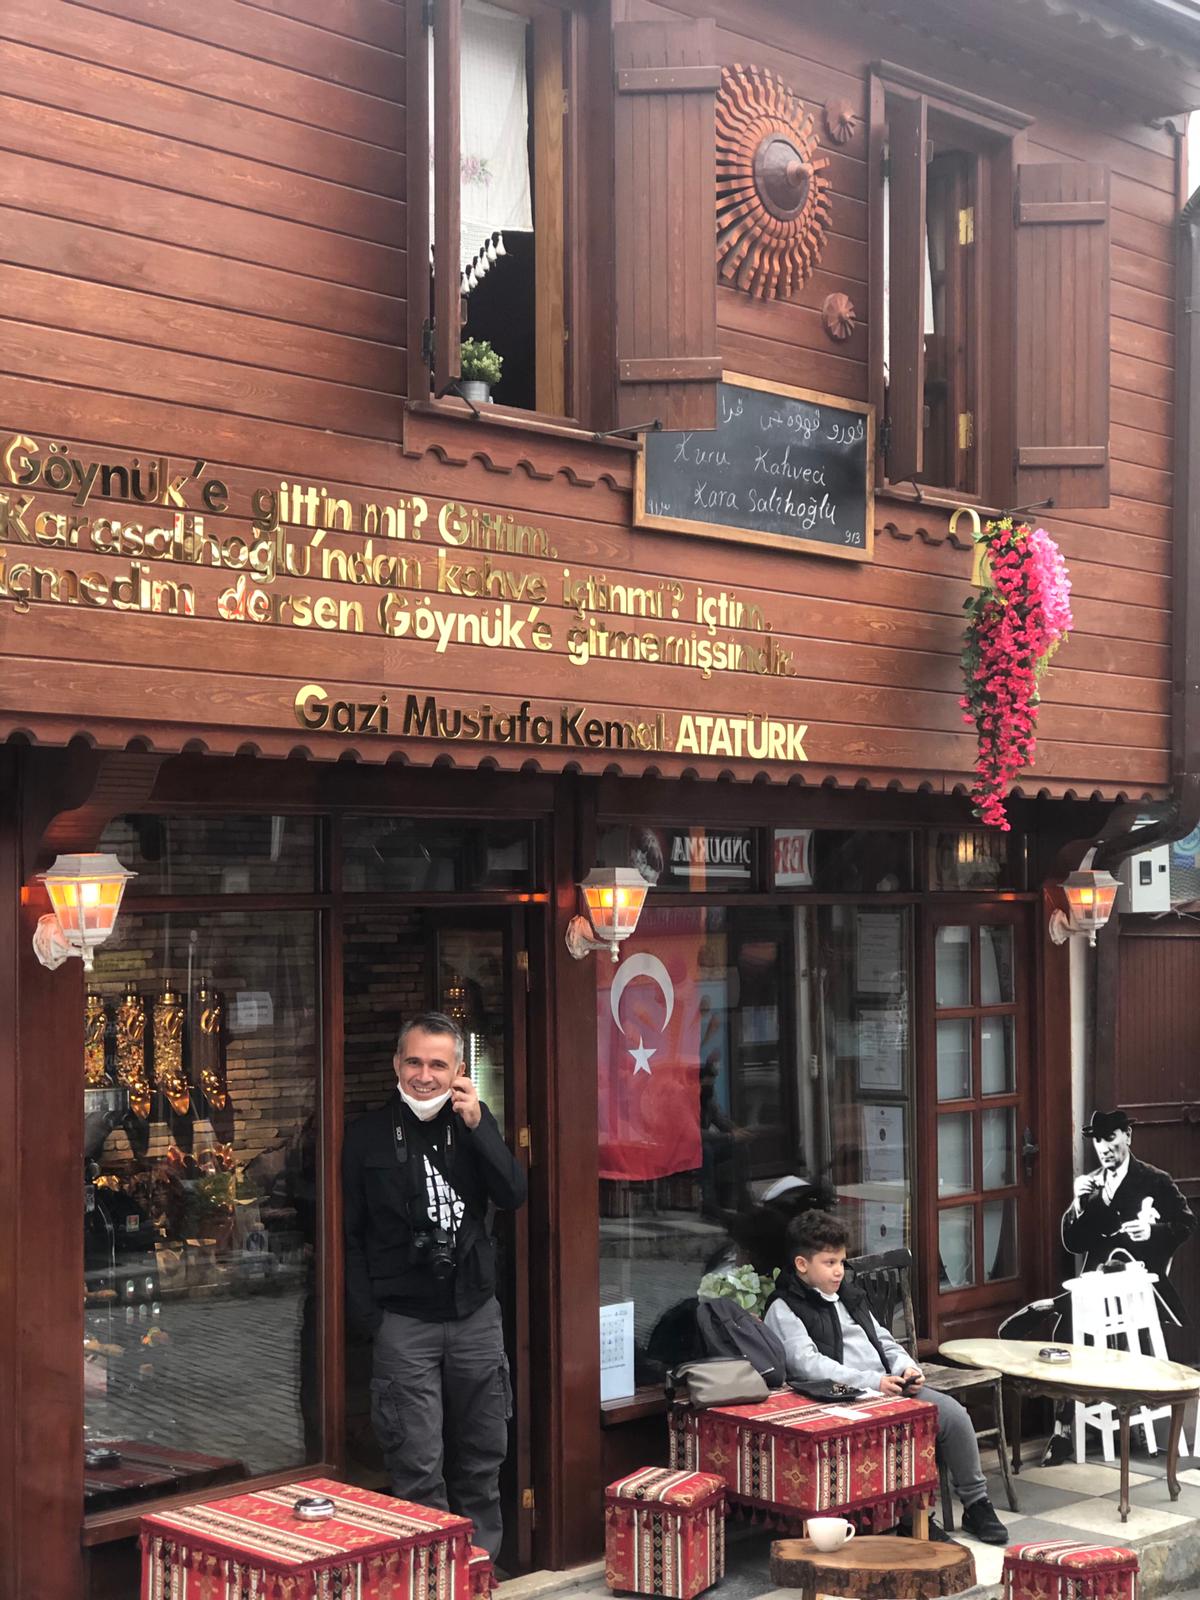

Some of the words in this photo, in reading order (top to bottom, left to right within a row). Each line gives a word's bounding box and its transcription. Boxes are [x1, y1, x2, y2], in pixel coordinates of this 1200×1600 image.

[252, 481, 352, 532] gittin
[360, 496, 428, 540] mi?
[438, 502, 558, 559] Gittim.
[694, 480, 738, 511] Kara
[748, 488, 836, 530] Salihoğlu
[217, 574, 364, 632] dersen
[377, 591, 553, 653] Göynük'e
[437, 548, 548, 604] kahve
[294, 684, 389, 733] Gazi
[403, 694, 553, 745] Mustafa
[560, 705, 666, 751] Kemal
[675, 710, 809, 762] ATATÜRK
